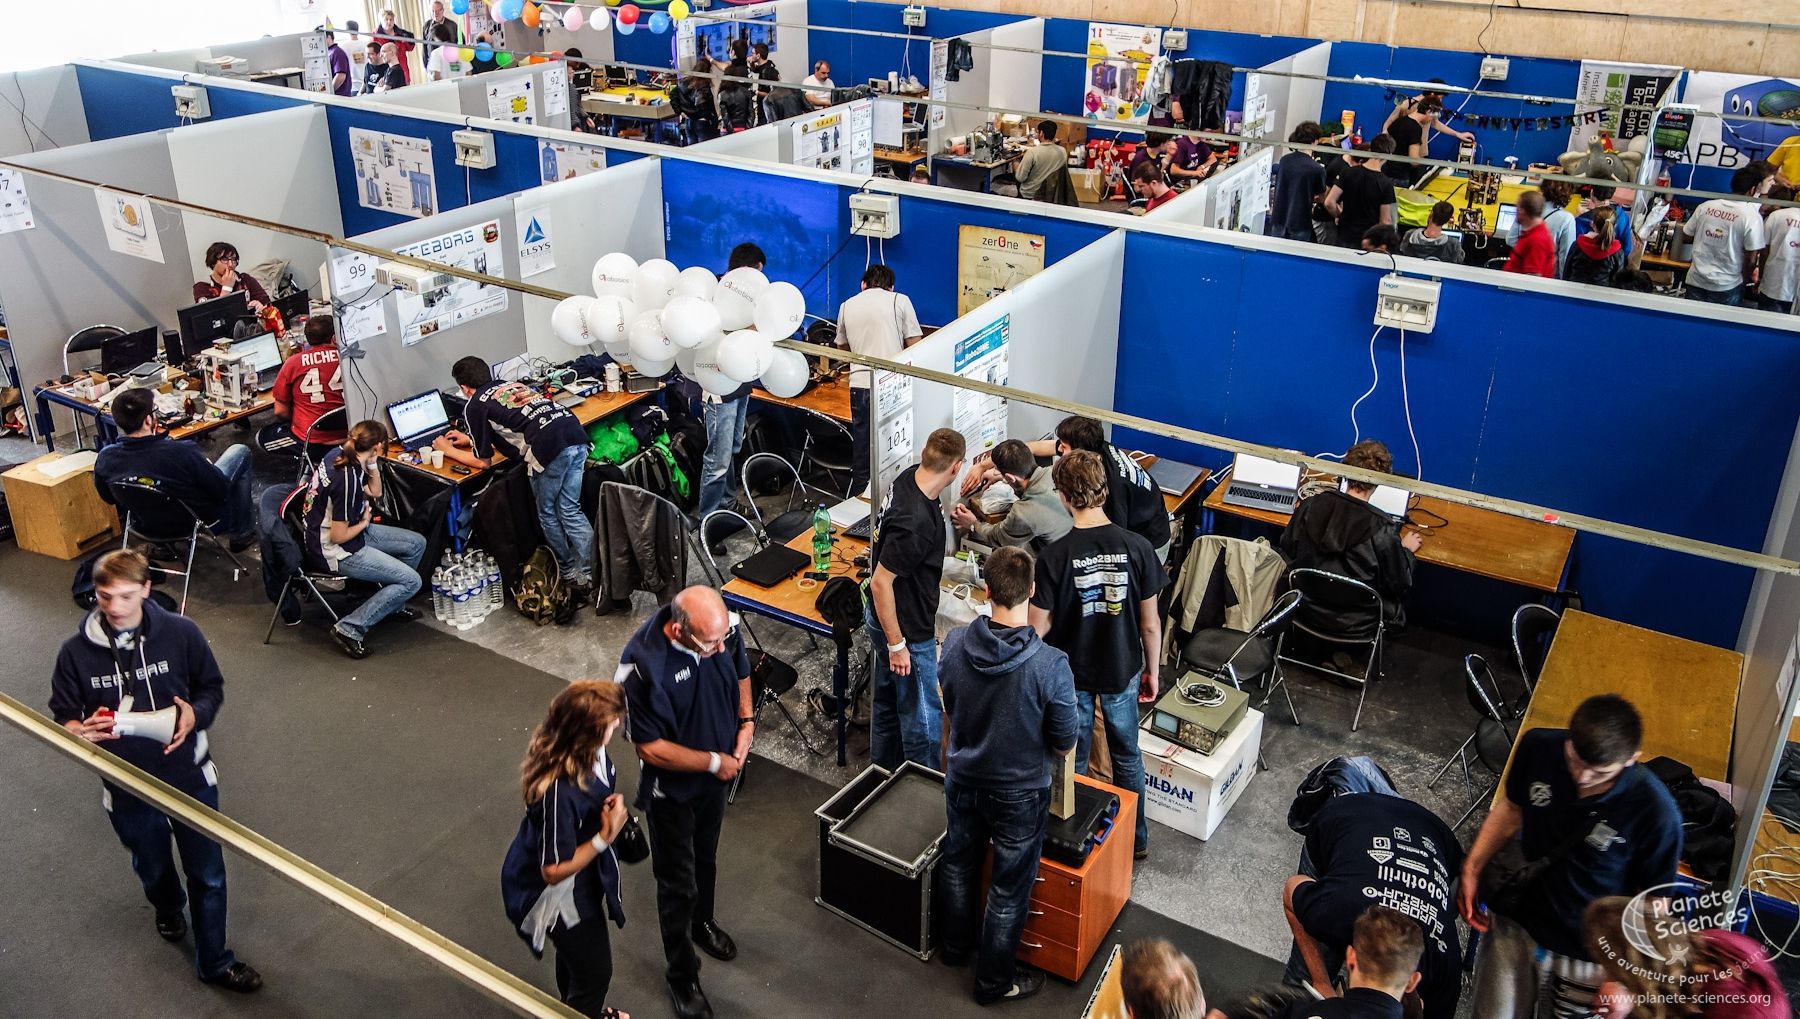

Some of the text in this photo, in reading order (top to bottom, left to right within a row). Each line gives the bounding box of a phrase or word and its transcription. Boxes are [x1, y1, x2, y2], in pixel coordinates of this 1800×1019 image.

[309, 41, 319, 51] 94
[551, 77, 560, 86] 92
[1664, 149, 1682, 159] 45€
[1705, 207, 1739, 222] MOULY
[520, 242, 551, 258] ELSYS
[349, 263, 367, 280] 99
[299, 365, 345, 404] 44
[887, 427, 907, 452] 101
[1072, 553, 1129, 569] Robo2BME
[90, 660, 170, 690] ECEORG
[1377, 865, 1448, 911] Robothrill
[1378, 896, 1445, 935] EUROBOT
